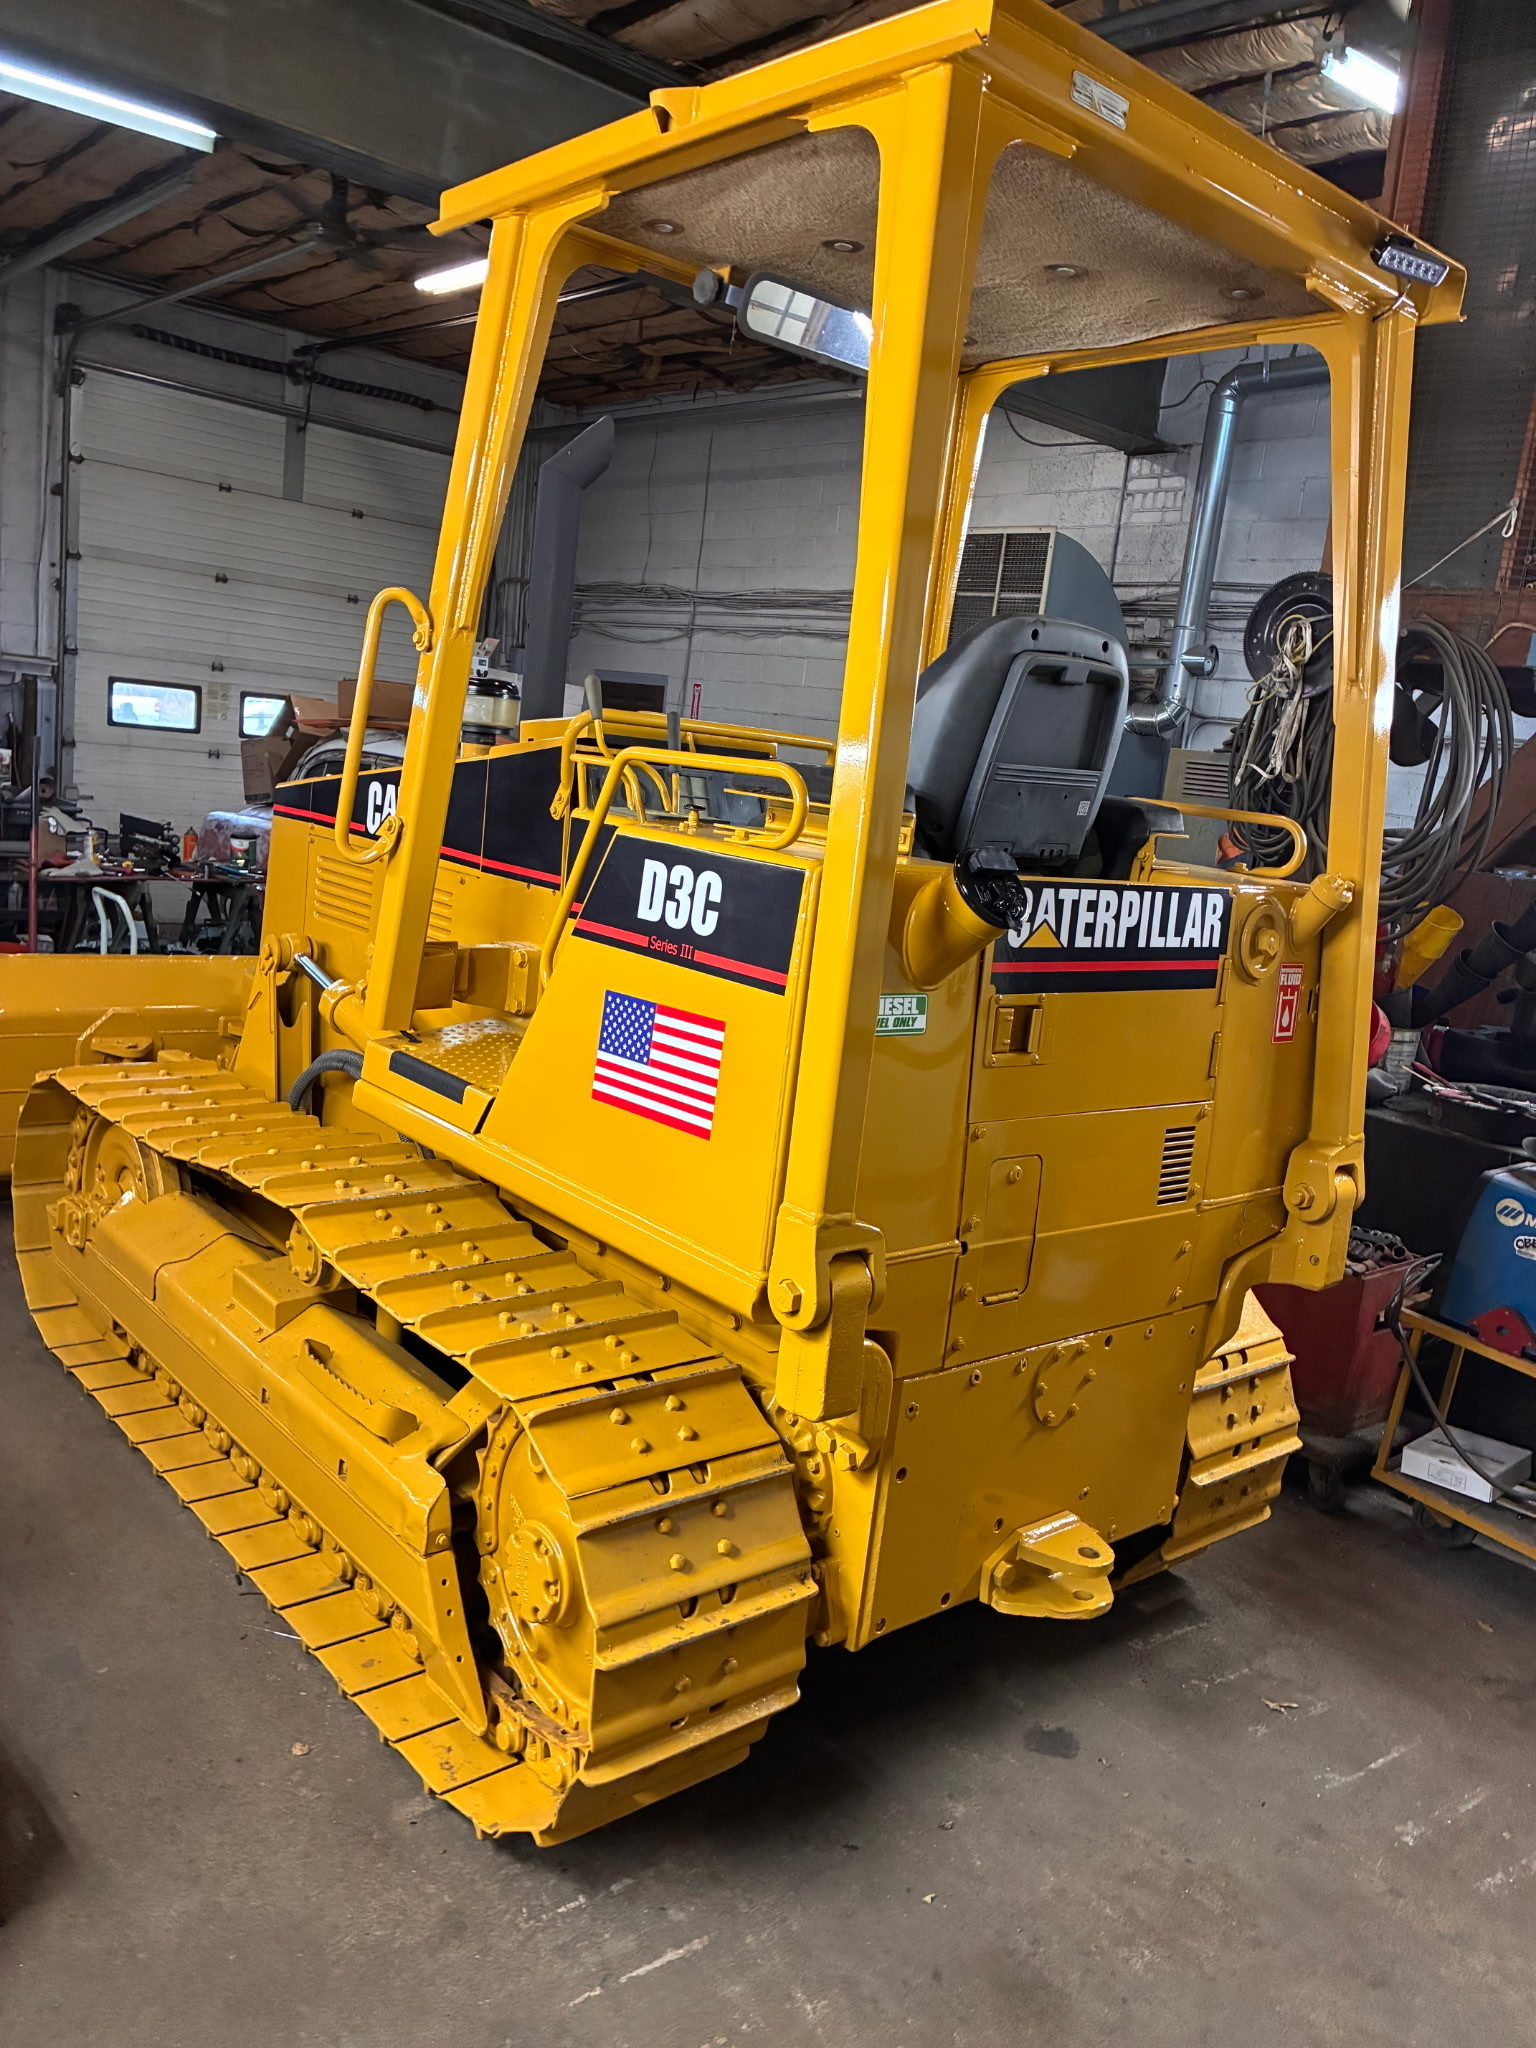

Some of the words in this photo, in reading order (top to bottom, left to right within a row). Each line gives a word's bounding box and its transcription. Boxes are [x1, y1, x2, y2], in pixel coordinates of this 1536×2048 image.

[366, 781, 397, 835] CA
[637, 858, 723, 937] D3C
[650, 936, 678, 955] Series
[1280, 974, 1302, 986] FLUID
[878, 997, 919, 1015] IESEL
[892, 1016, 918, 1028] ONLY
